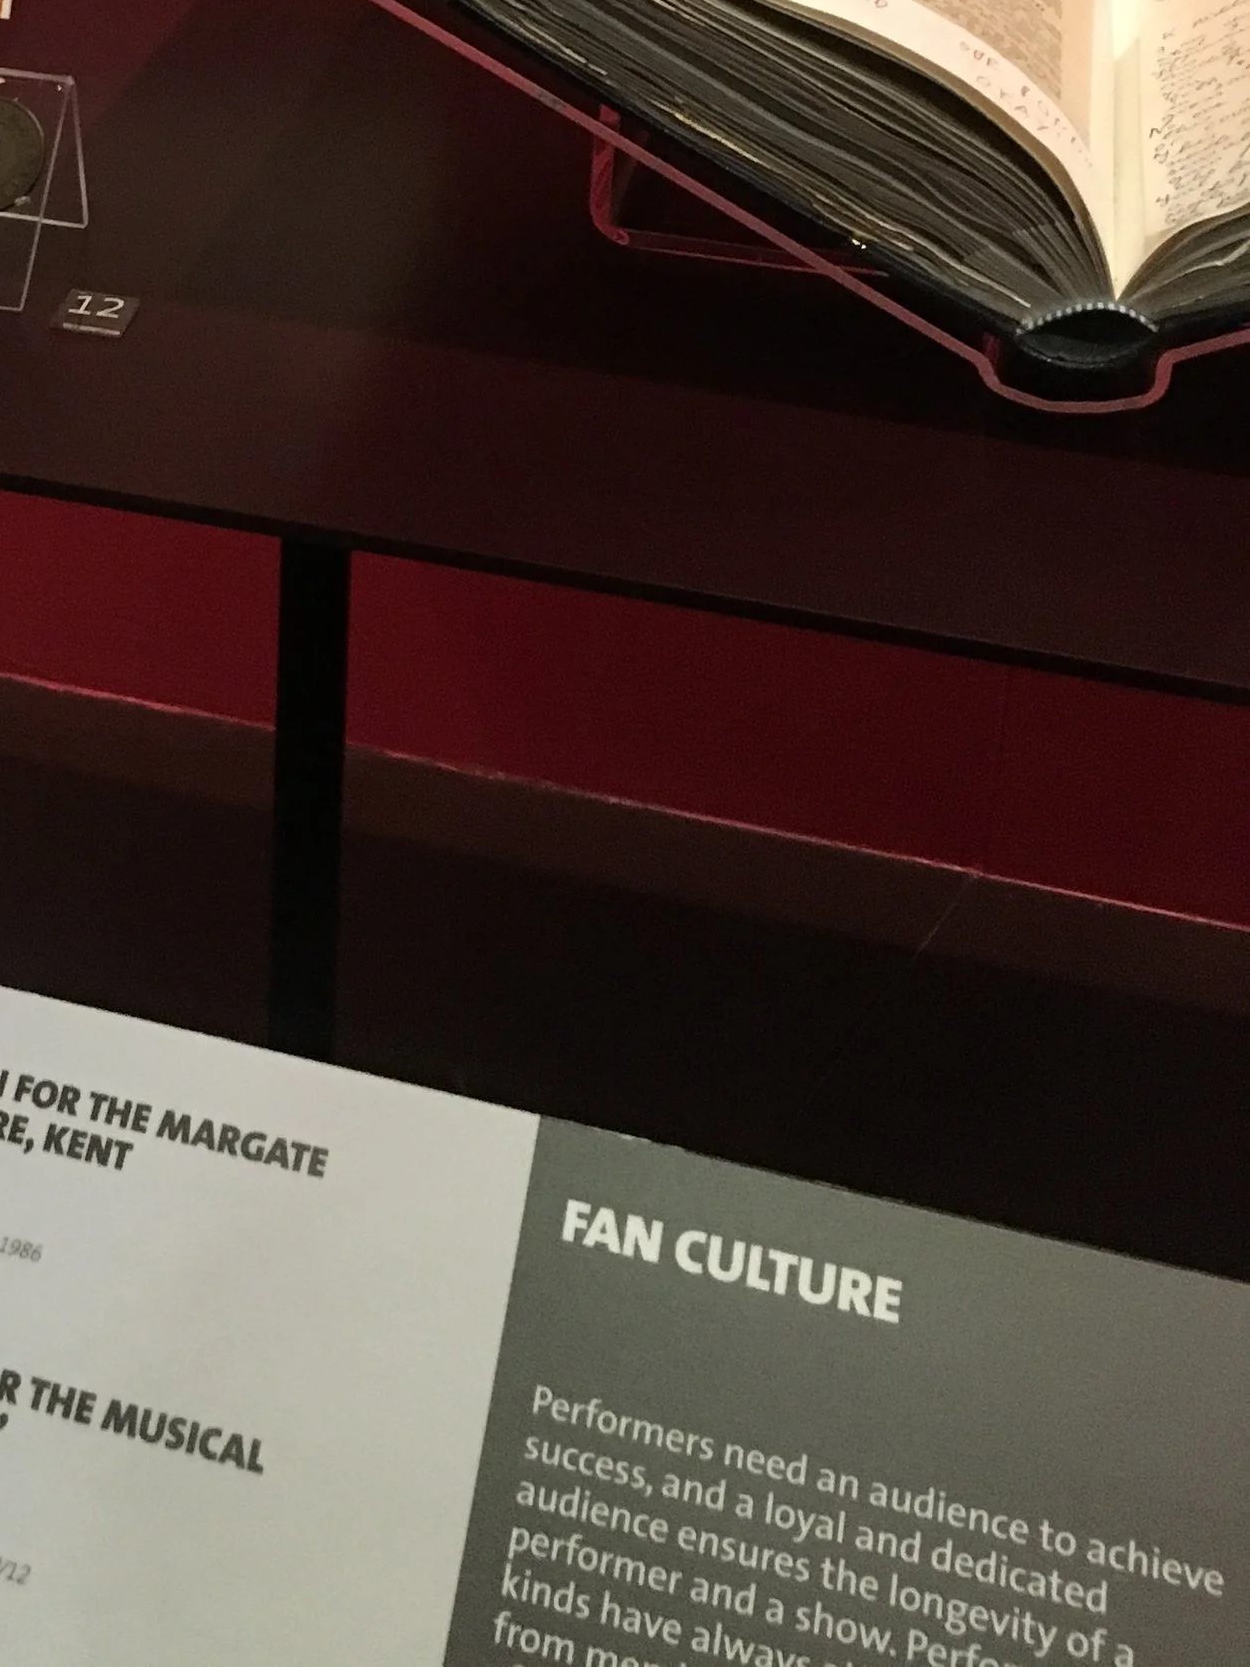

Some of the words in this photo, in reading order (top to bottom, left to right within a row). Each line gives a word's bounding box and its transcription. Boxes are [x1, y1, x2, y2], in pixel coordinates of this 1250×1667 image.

[68, 294, 125, 319] 12
[14, 1074, 81, 1116] FOR
[90, 1092, 152, 1133] THE
[156, 1110, 328, 1177] MARGATE
[43, 1123, 133, 1170] KENT
[562, 1199, 663, 1263] FAN
[675, 1231, 902, 1323] CULTURE
[31, 1377, 96, 1424] THE
[101, 1399, 263, 1474] MUSICAL
[525, 1437, 652, 1497] success,
[662, 1474, 726, 1511] and
[735, 1494, 753, 1519] a
[766, 1492, 845, 1543] loyal
[855, 1527, 921, 1564] and
[931, 1539, 1107, 1614] dedicated
[533, 1385, 713, 1460] Performers
[724, 1444, 807, 1485] need
[817, 1469, 858, 1499] an
[870, 1483, 1029, 1544] audience
[1039, 1520, 1076, 1556] to
[1087, 1539, 1224, 1596] achieve
[501, 1563, 591, 1620] kinds
[600, 1589, 682, 1646] have
[508, 1526, 683, 1594] performer
[691, 1578, 756, 1616] and
[766, 1598, 783, 1624] a
[795, 1600, 897, 1658] show.
[516, 1481, 668, 1543] audience
[678, 1527, 809, 1582] ensures
[821, 1558, 878, 1601] the
[890, 1573, 1057, 1655] longevity
[1067, 1628, 1107, 1662] of
[1114, 1644, 1134, 1667] a
[494, 1610, 574, 1666] from
